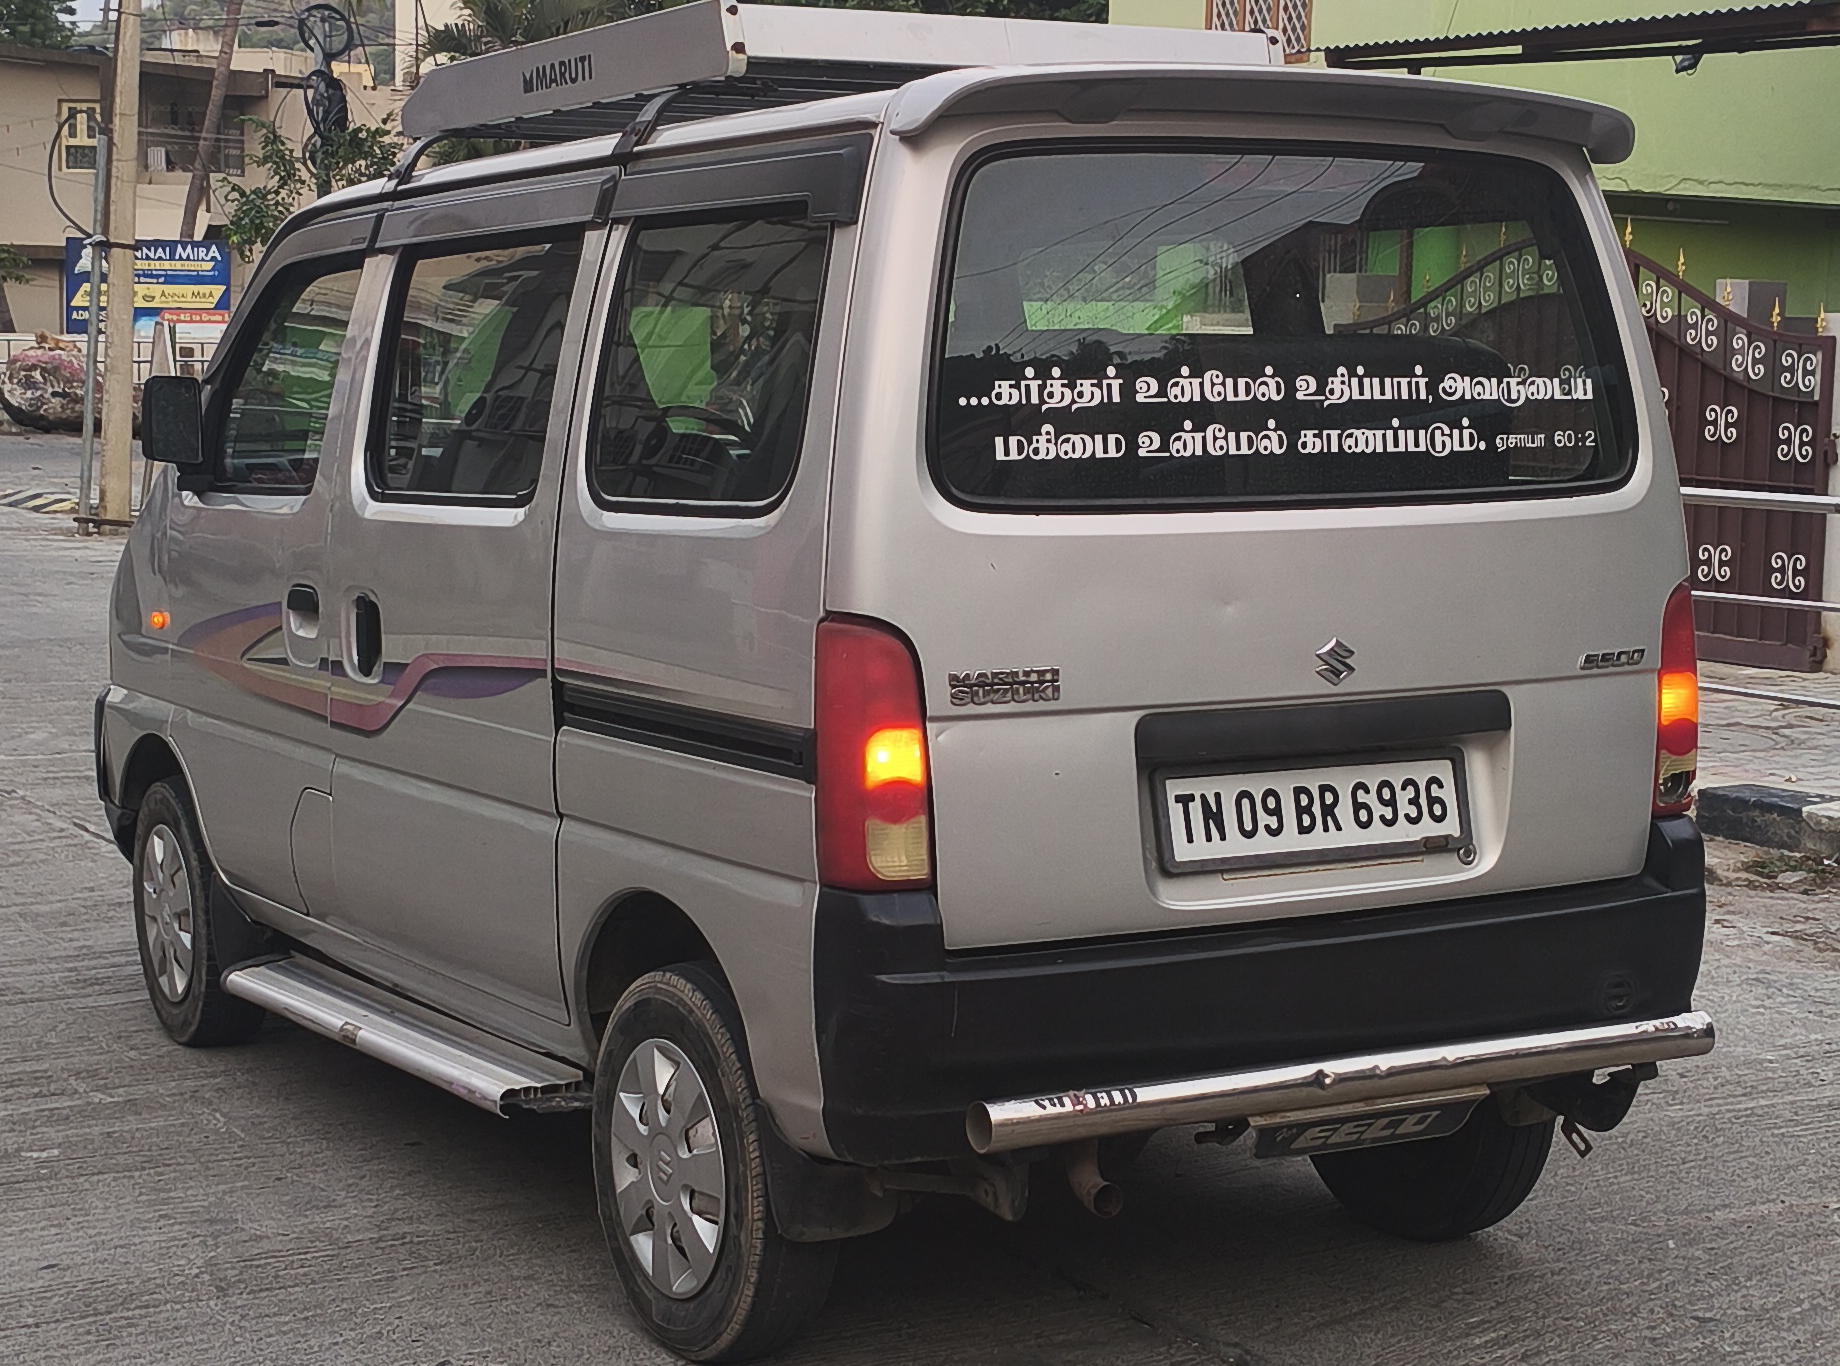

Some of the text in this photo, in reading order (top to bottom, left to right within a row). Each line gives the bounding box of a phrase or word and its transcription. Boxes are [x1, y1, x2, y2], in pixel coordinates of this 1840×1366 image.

[535, 53, 593, 92] MARUTI
[134, 246, 170, 260] NNAI
[1135, 365, 1285, 403] உன்மேல்
[1295, 365, 1433, 408] உதிப்பார்,
[1438, 372, 1594, 407] அவருடைய
[994, 417, 1596, 461] மகிமை உன்மேல் காணப்படும். ஏசாயா 60:2
[948, 666, 1060, 687] MARUTI
[950, 682, 1060, 706] SUZUKI
[1174, 775, 1448, 844] TN 09 BR 6936
[1290, 1110, 1442, 1149] EECO
